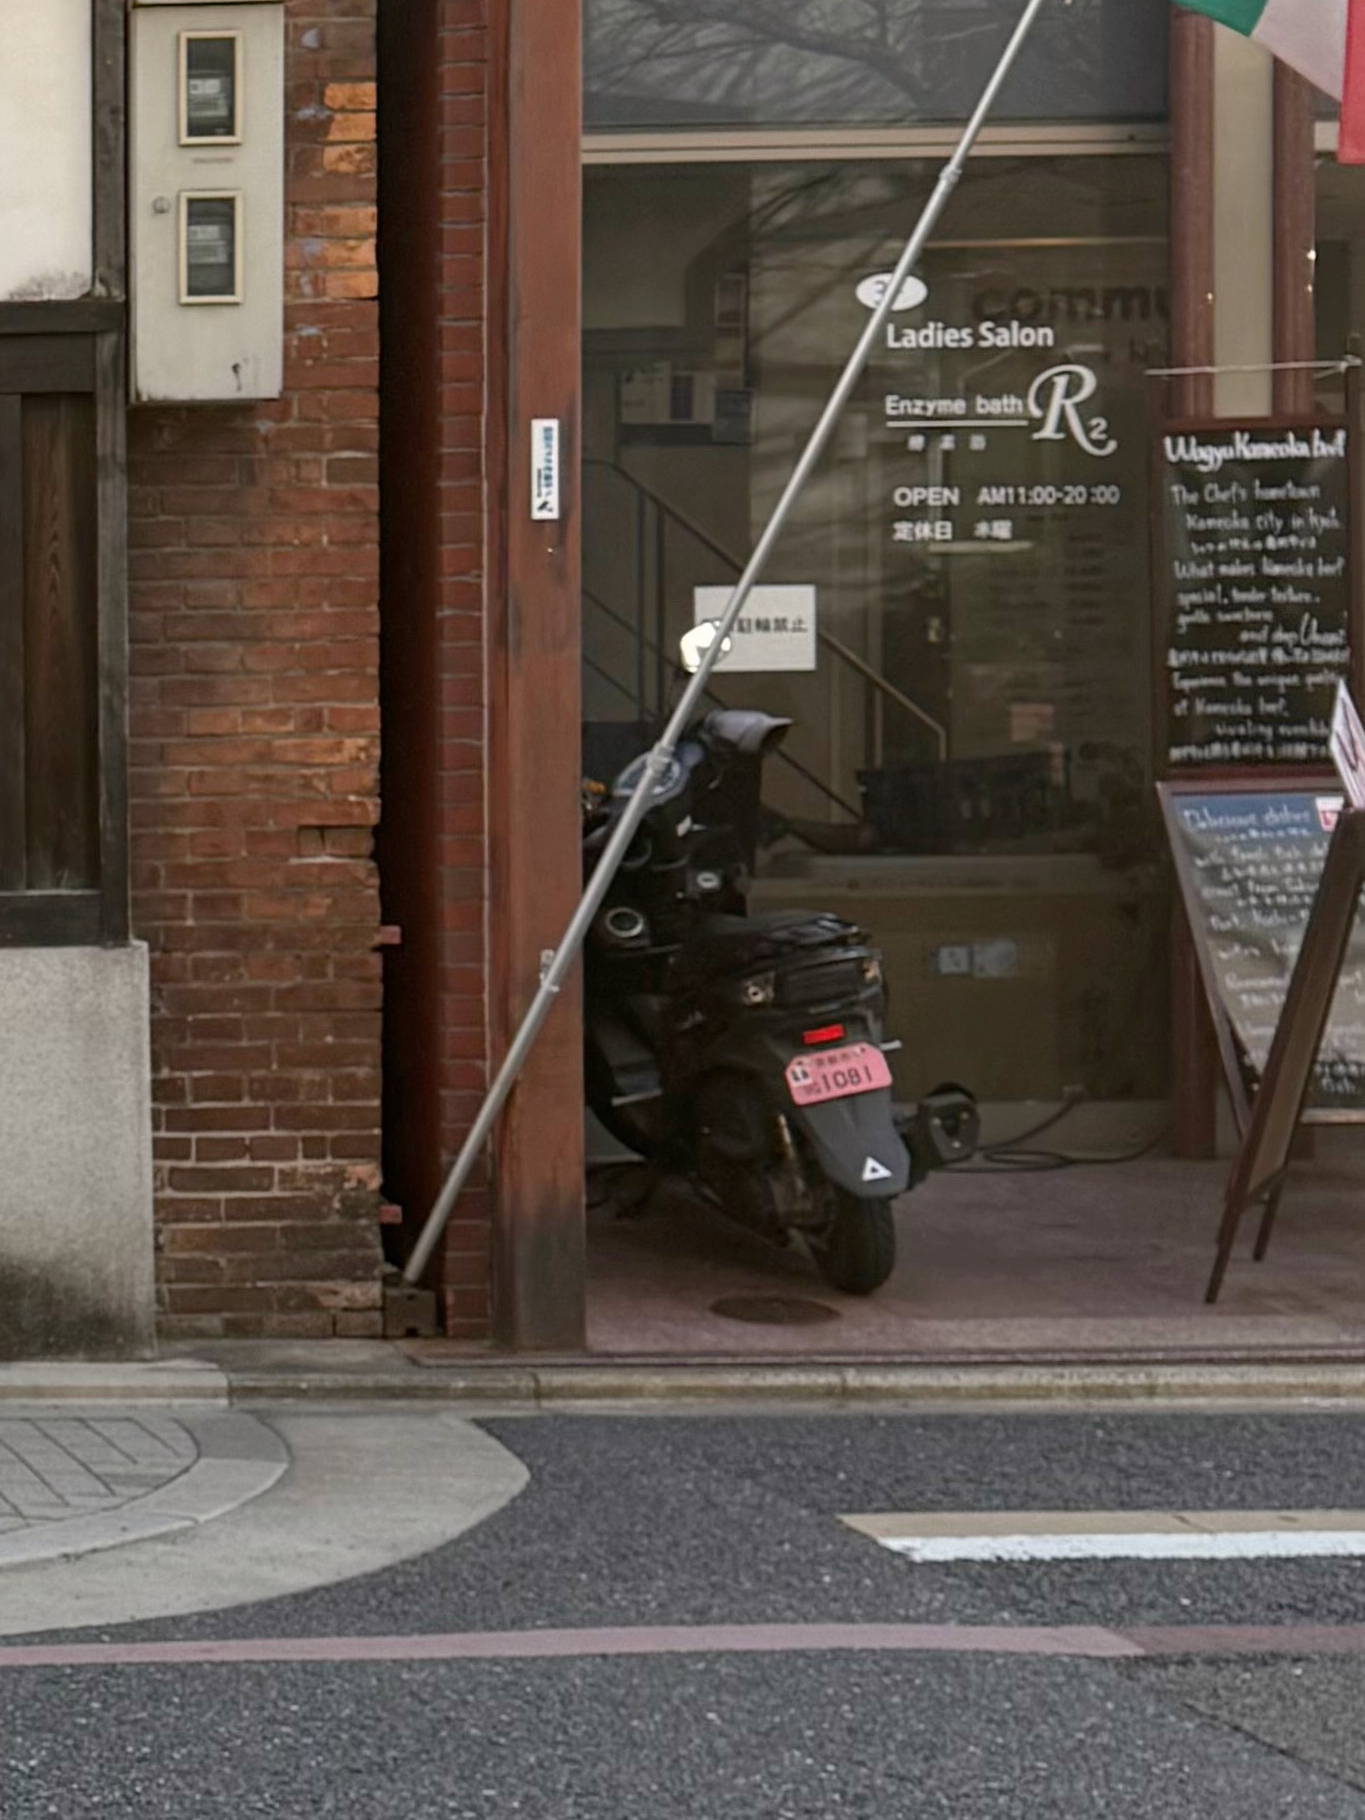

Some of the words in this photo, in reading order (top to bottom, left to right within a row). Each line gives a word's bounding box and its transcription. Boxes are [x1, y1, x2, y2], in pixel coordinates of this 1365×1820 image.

[886, 322, 974, 349] Ladies
[978, 320, 1055, 348] Salon
[885, 394, 966, 417] Enzyme
[975, 394, 1023, 415] bath
[893, 486, 960, 507] OPEN
[892, 520, 952, 541] 定休日
[821, 1065, 873, 1093] 1081
